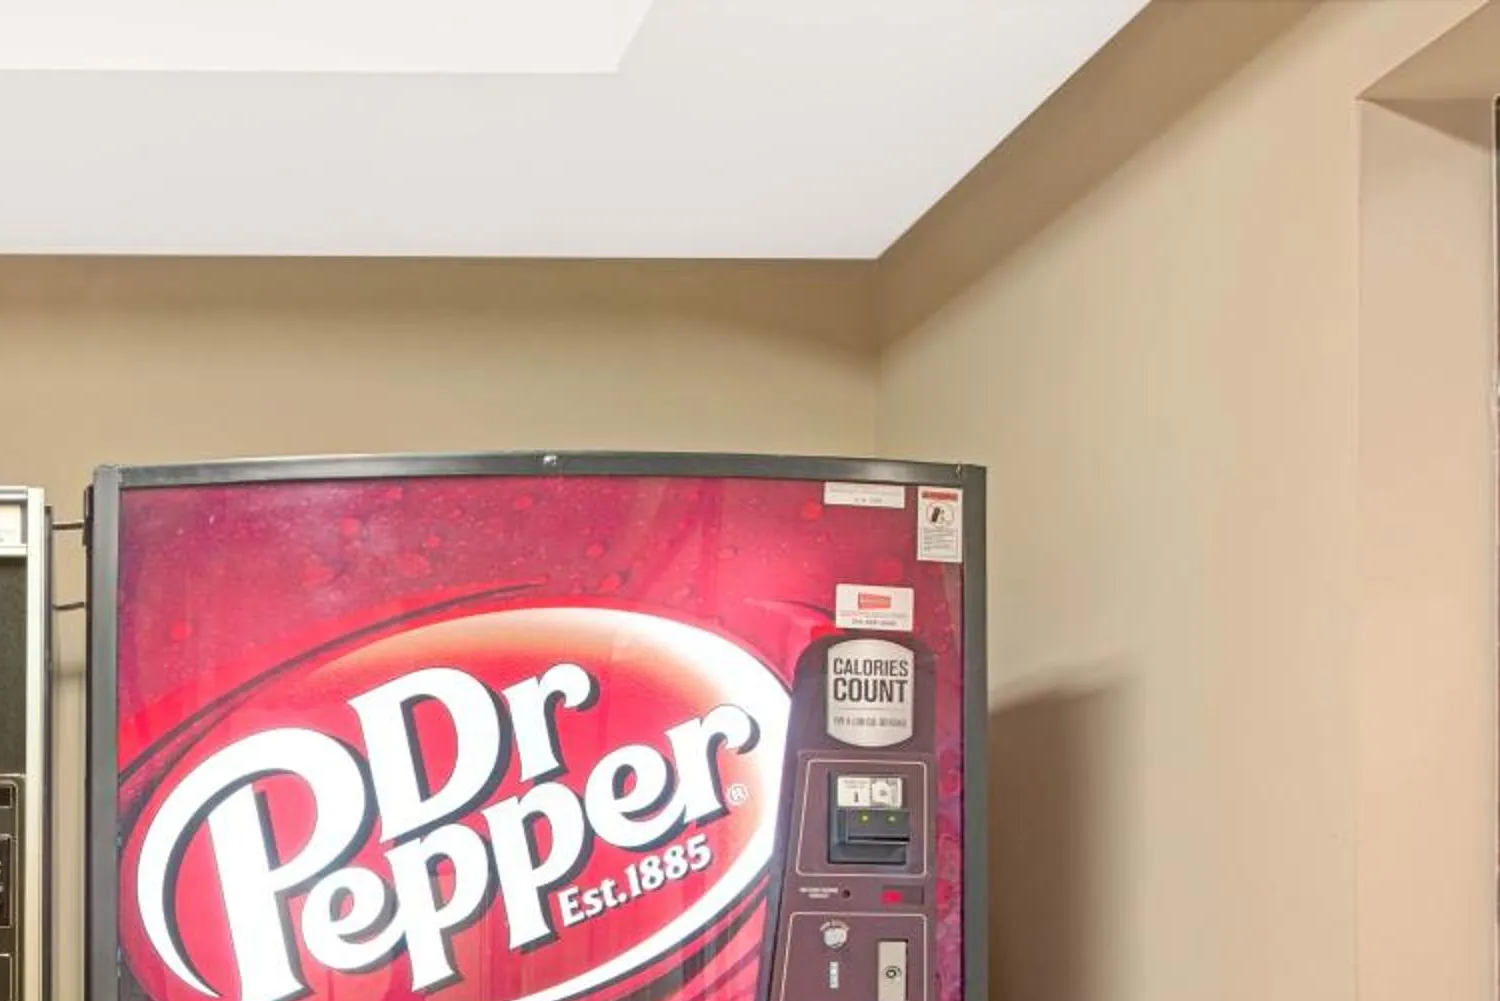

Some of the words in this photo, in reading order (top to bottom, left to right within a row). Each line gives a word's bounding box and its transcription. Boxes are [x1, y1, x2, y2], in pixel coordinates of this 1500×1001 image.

[833, 658, 909, 677] CALORIES
[833, 677, 909, 703] COUNT
[347, 663, 593, 843] Dr
